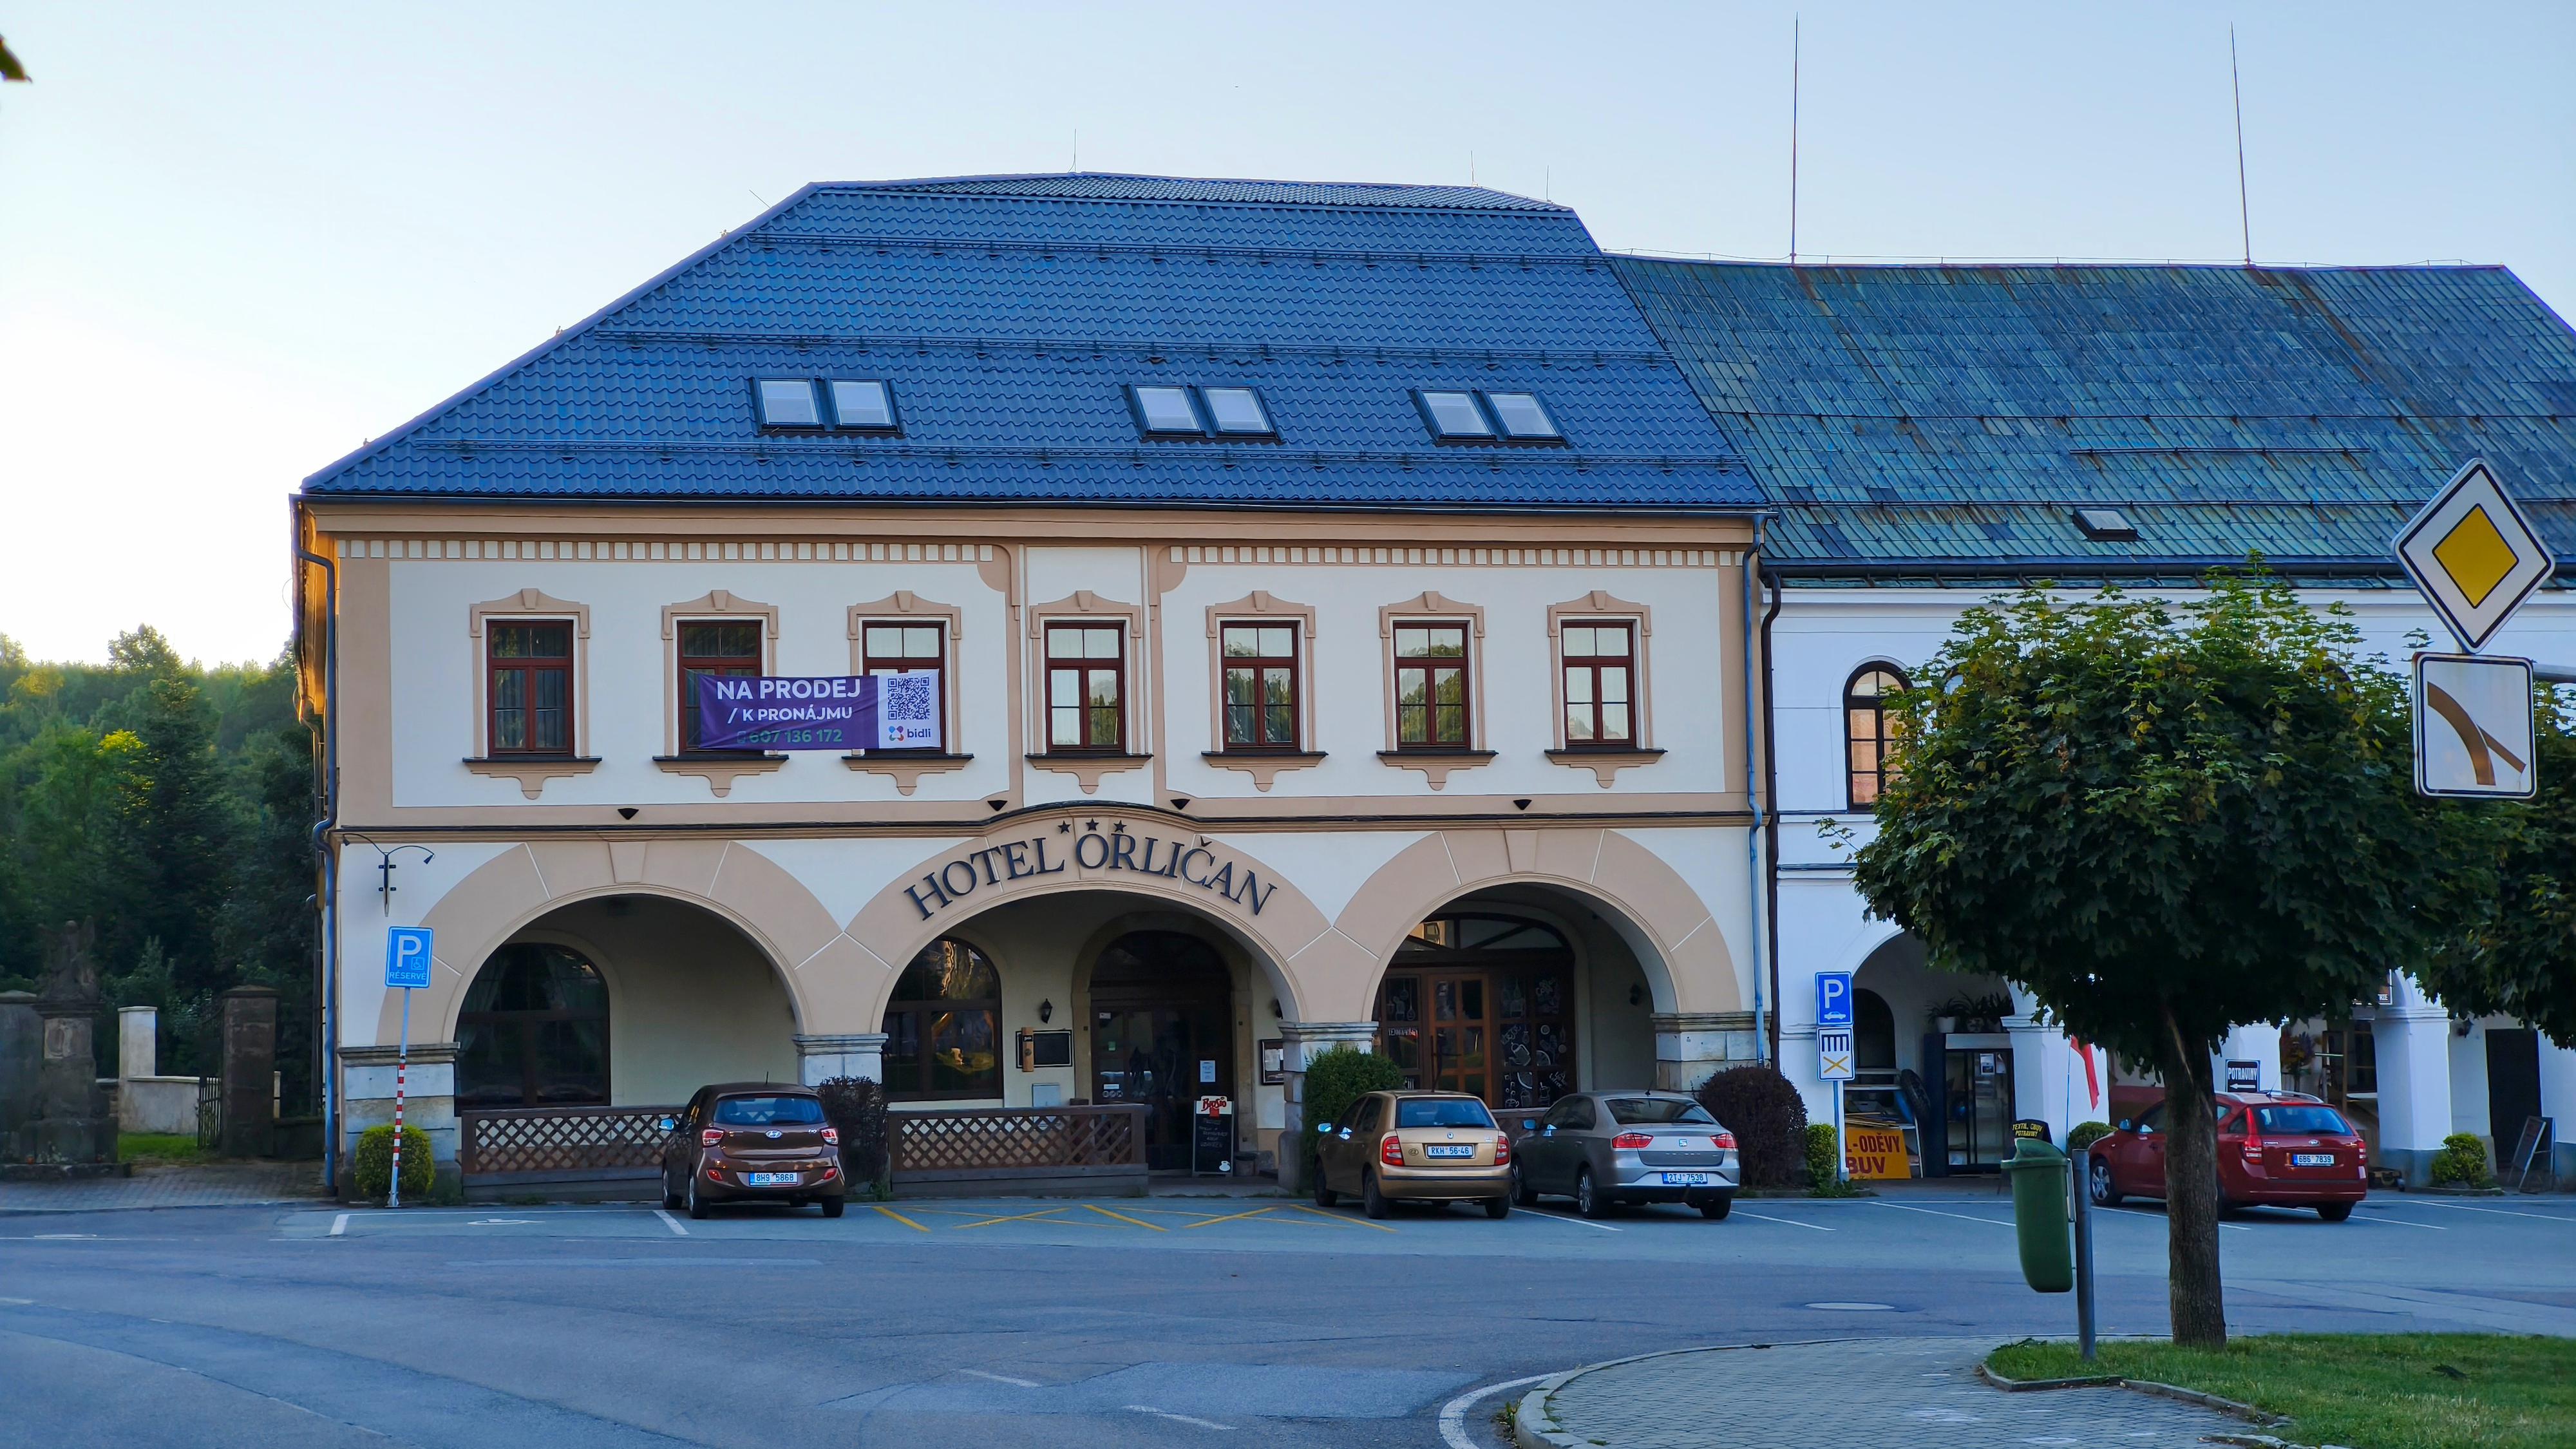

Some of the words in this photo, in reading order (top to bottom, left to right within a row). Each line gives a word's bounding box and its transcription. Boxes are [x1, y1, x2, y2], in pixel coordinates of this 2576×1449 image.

[717, 680, 753, 700] NA
[760, 679, 860, 699] PRODEJ
[743, 709, 754, 721] K
[758, 704, 853, 721] PRONÁJMU
[749, 730, 779, 743] 607
[784, 730, 811, 743] 136
[817, 729, 842, 742] 172
[907, 728, 931, 738] bidli
[904, 837, 1065, 921] HOTEL
[1076, 833, 1277, 916] ORLIČAN
[396, 934, 422, 967] P
[1824, 979, 1844, 1009] P
[2228, 1067, 2258, 1080] POTRAVINY
[1449, 1146, 1469, 1155] 56-46
[1846, 1156, 1886, 1174] BUV
[756, 1173, 770, 1182] 8H9
